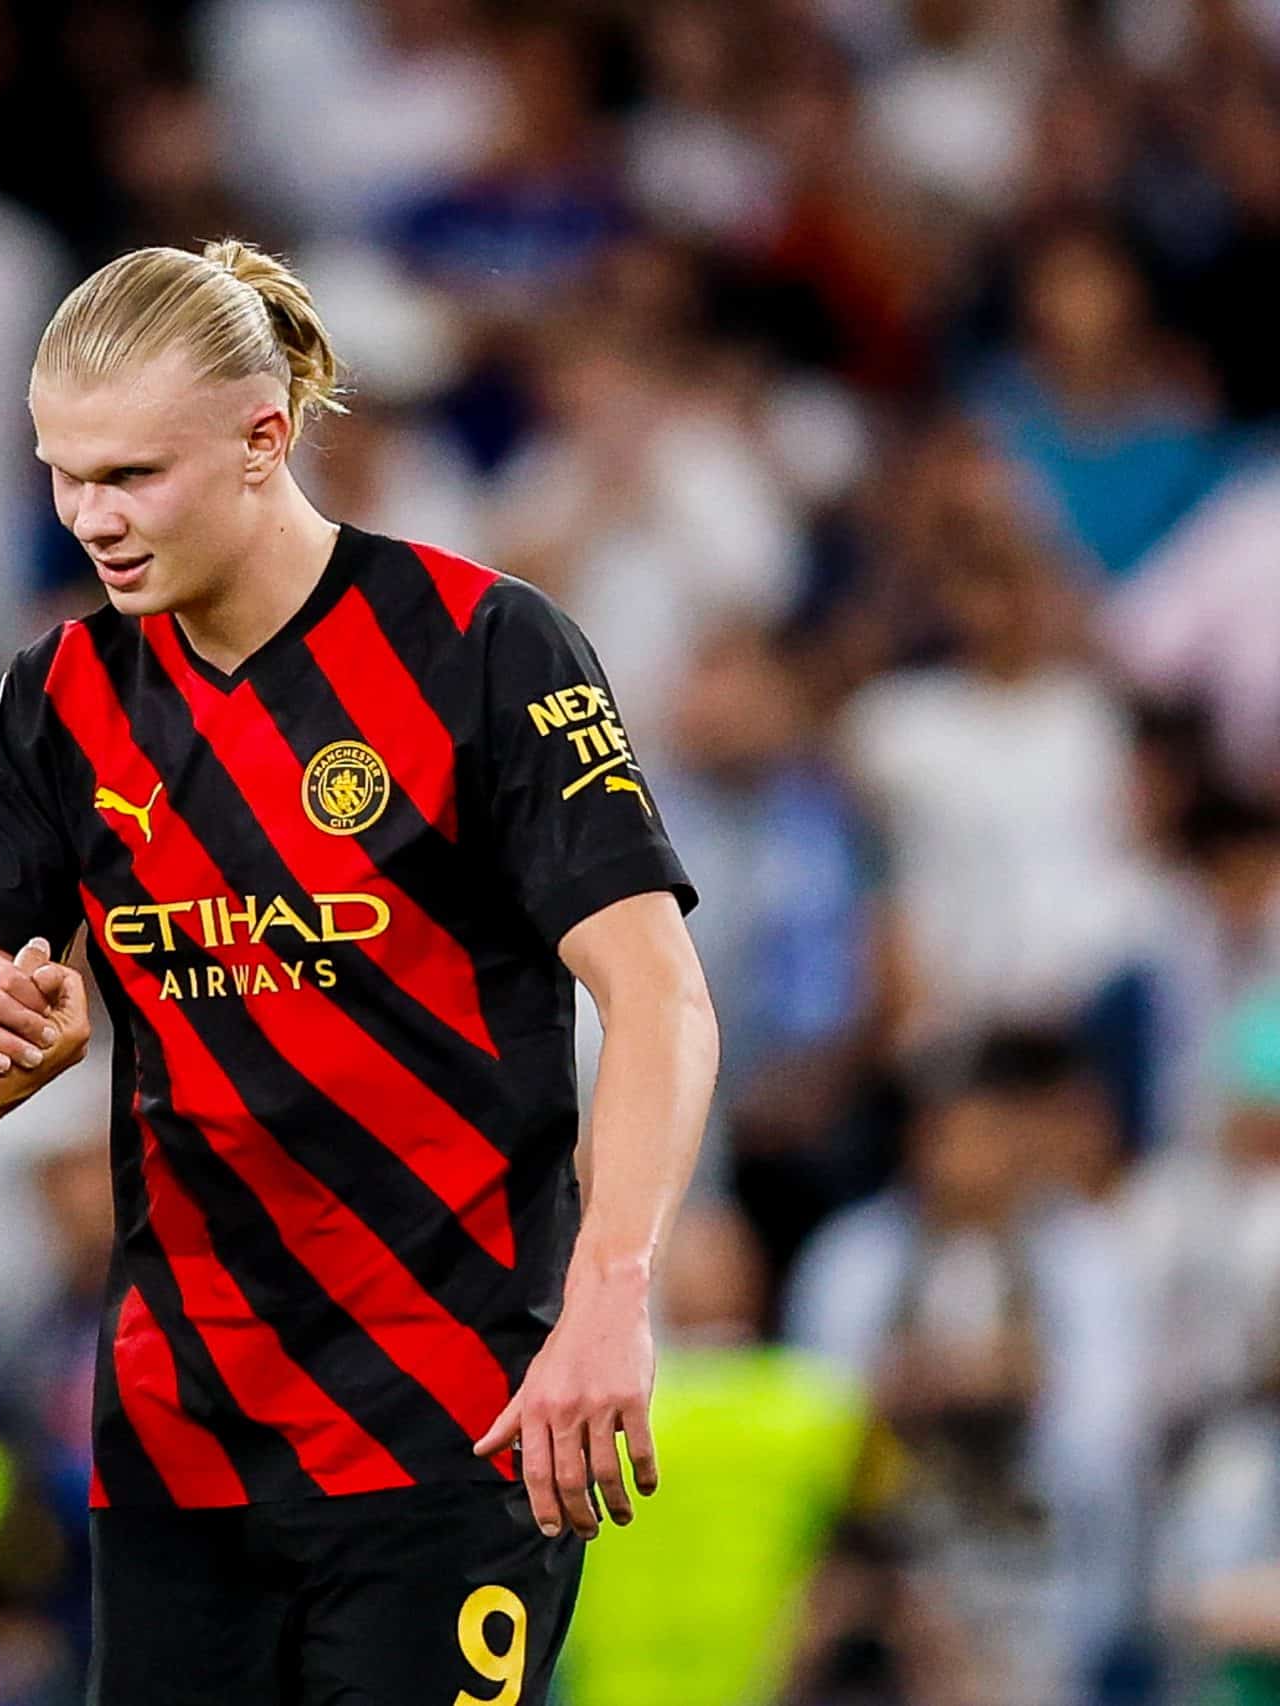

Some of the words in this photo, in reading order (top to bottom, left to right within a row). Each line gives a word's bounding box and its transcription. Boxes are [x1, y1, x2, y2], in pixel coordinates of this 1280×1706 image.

[313, 748, 381, 777] MANCHESTER
[330, 818, 356, 828] CITY
[104, 893, 391, 954] ETIHAD
[159, 959, 337, 1000] AIRWAYS
[452, 1584, 527, 1706] 9
